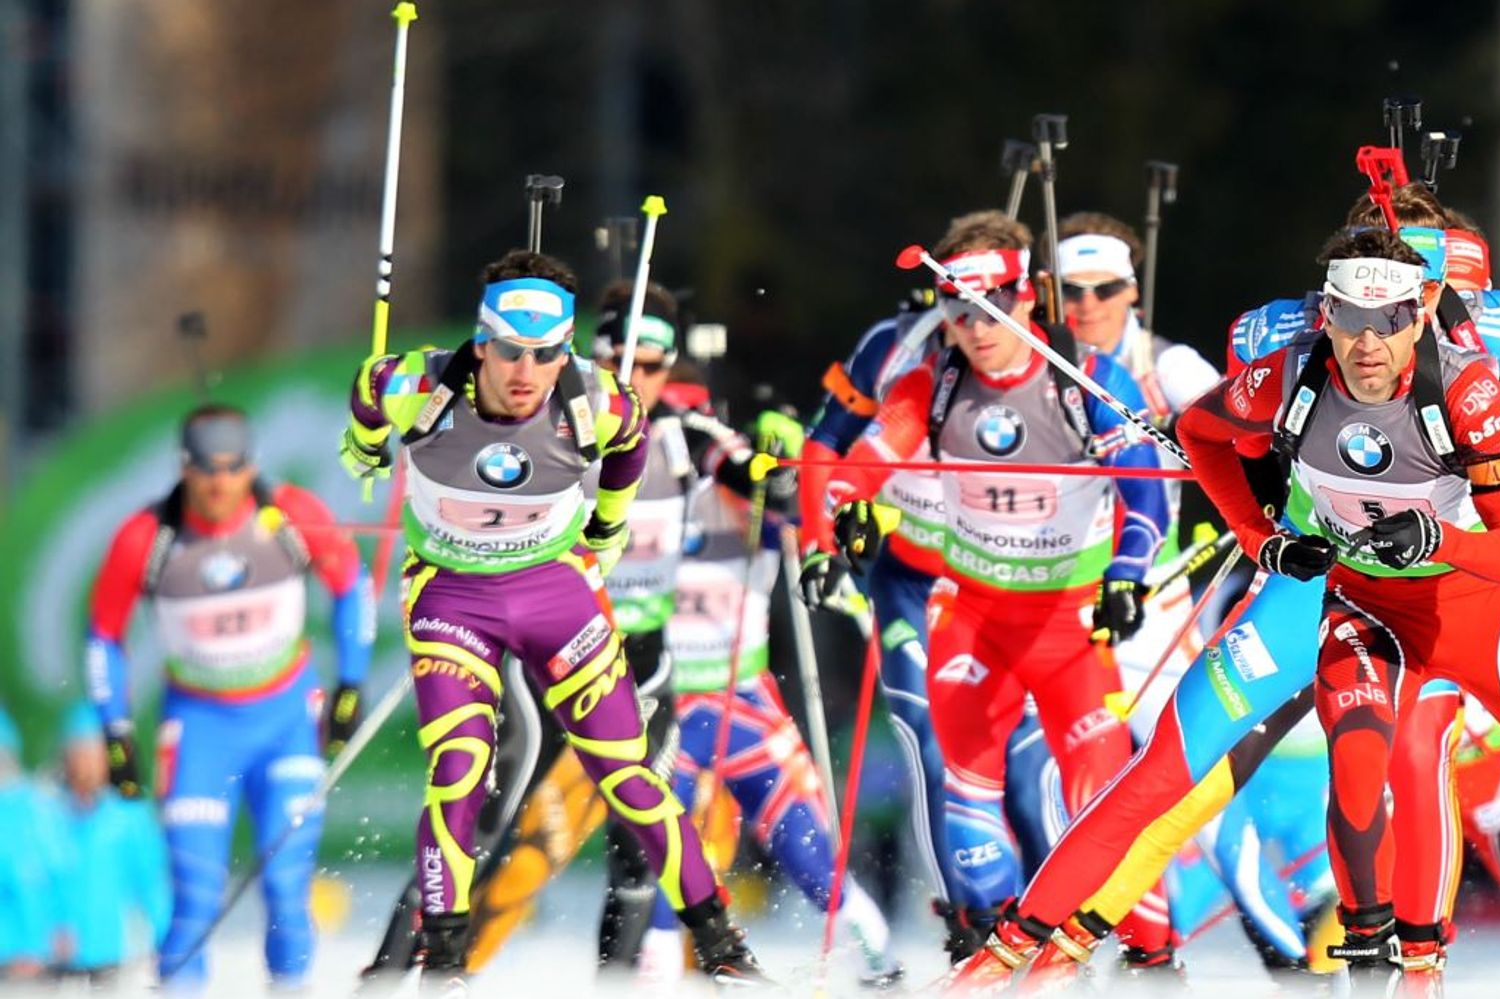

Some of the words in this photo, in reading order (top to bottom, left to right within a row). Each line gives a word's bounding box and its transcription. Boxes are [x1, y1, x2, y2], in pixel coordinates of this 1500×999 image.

[1355, 262, 1403, 285] DNB
[1461, 379, 1498, 415] DNB
[986, 488, 1018, 513] 11
[1034, 496, 1045, 511] 1
[1361, 501, 1386, 523] 5
[481, 508, 505, 528] 2
[957, 516, 1072, 549] RUHPOLDING
[950, 545, 1050, 581] ERDGAS
[413, 659, 481, 690] omfy
[1338, 684, 1388, 708] DNB
[955, 841, 1003, 867] CZE
[423, 846, 445, 914] RANCE
